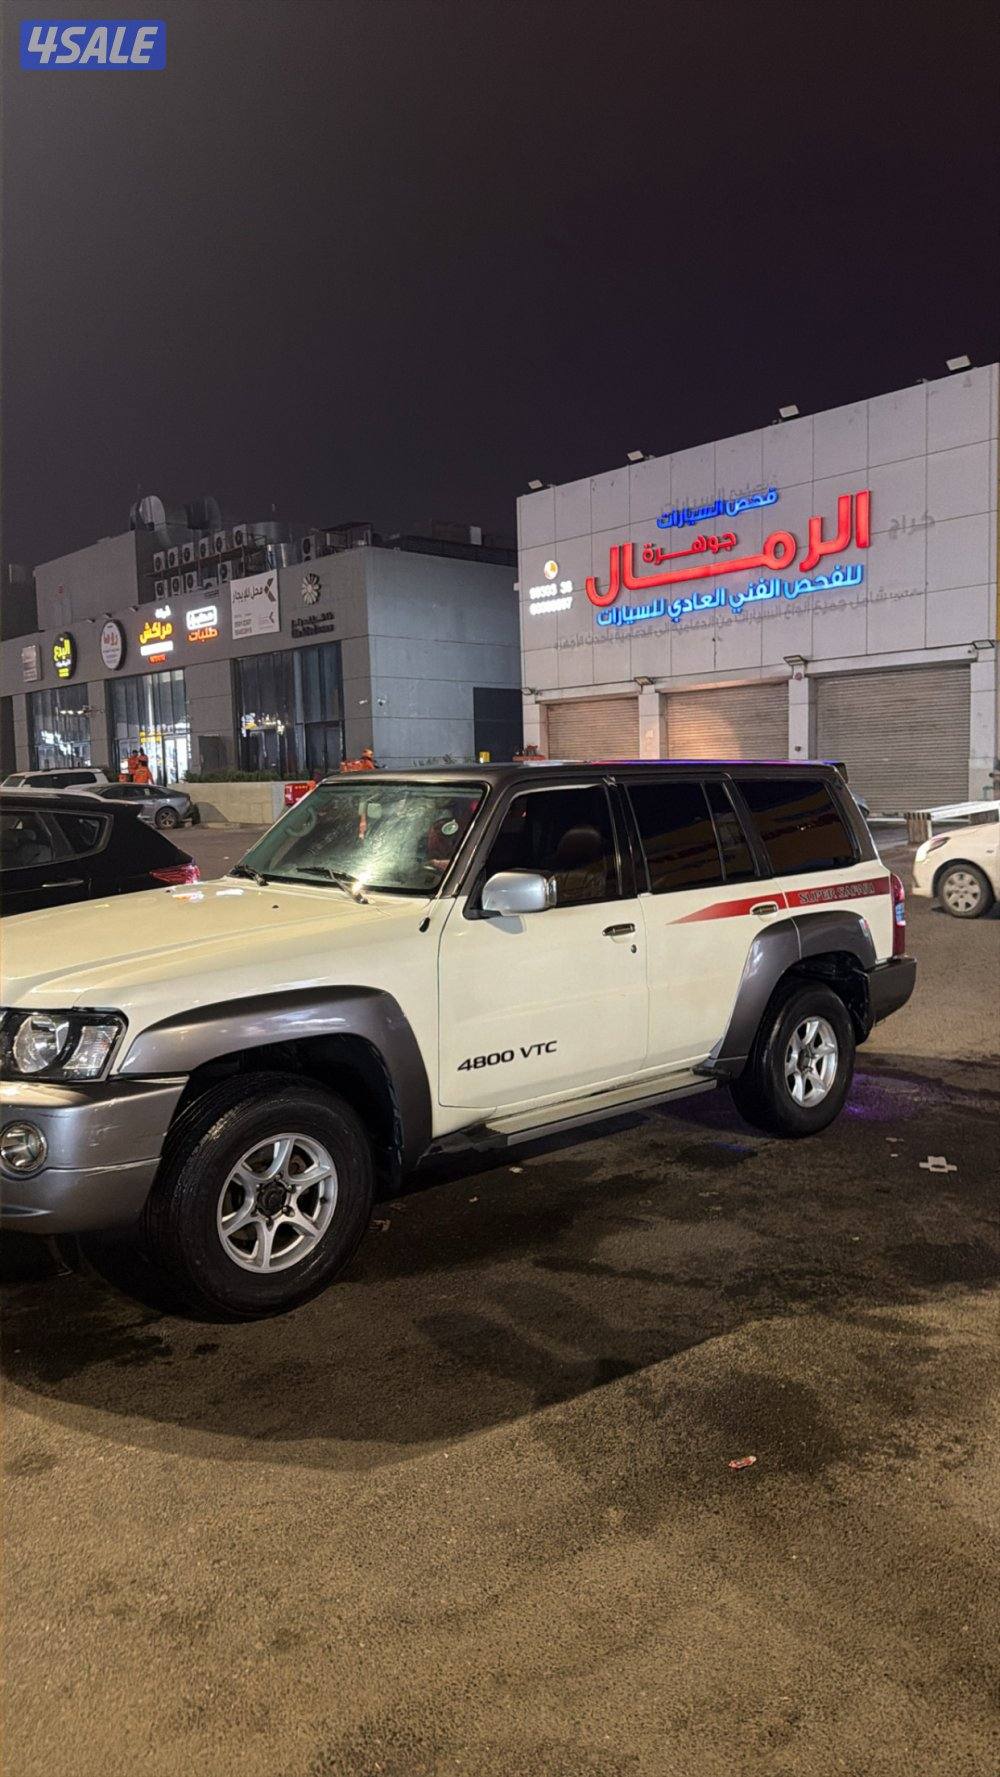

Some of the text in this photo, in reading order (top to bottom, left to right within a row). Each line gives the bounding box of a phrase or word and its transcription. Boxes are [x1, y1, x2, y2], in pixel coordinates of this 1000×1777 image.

[656, 497, 724, 529] السيارات
[725, 486, 779, 517] فحص
[585, 490, 871, 607] الرمال
[642, 531, 737, 566] جوهرة
[729, 577, 780, 614] الفني
[783, 564, 864, 600] للفحص
[596, 598, 665, 627] للسيارات
[667, 587, 725, 623] العادي
[140, 621, 173, 645] مراكش
[188, 627, 219, 643] طلبات
[798, 888, 837, 904] SUPER
[457, 1040, 558, 1072] 4800 VTC
